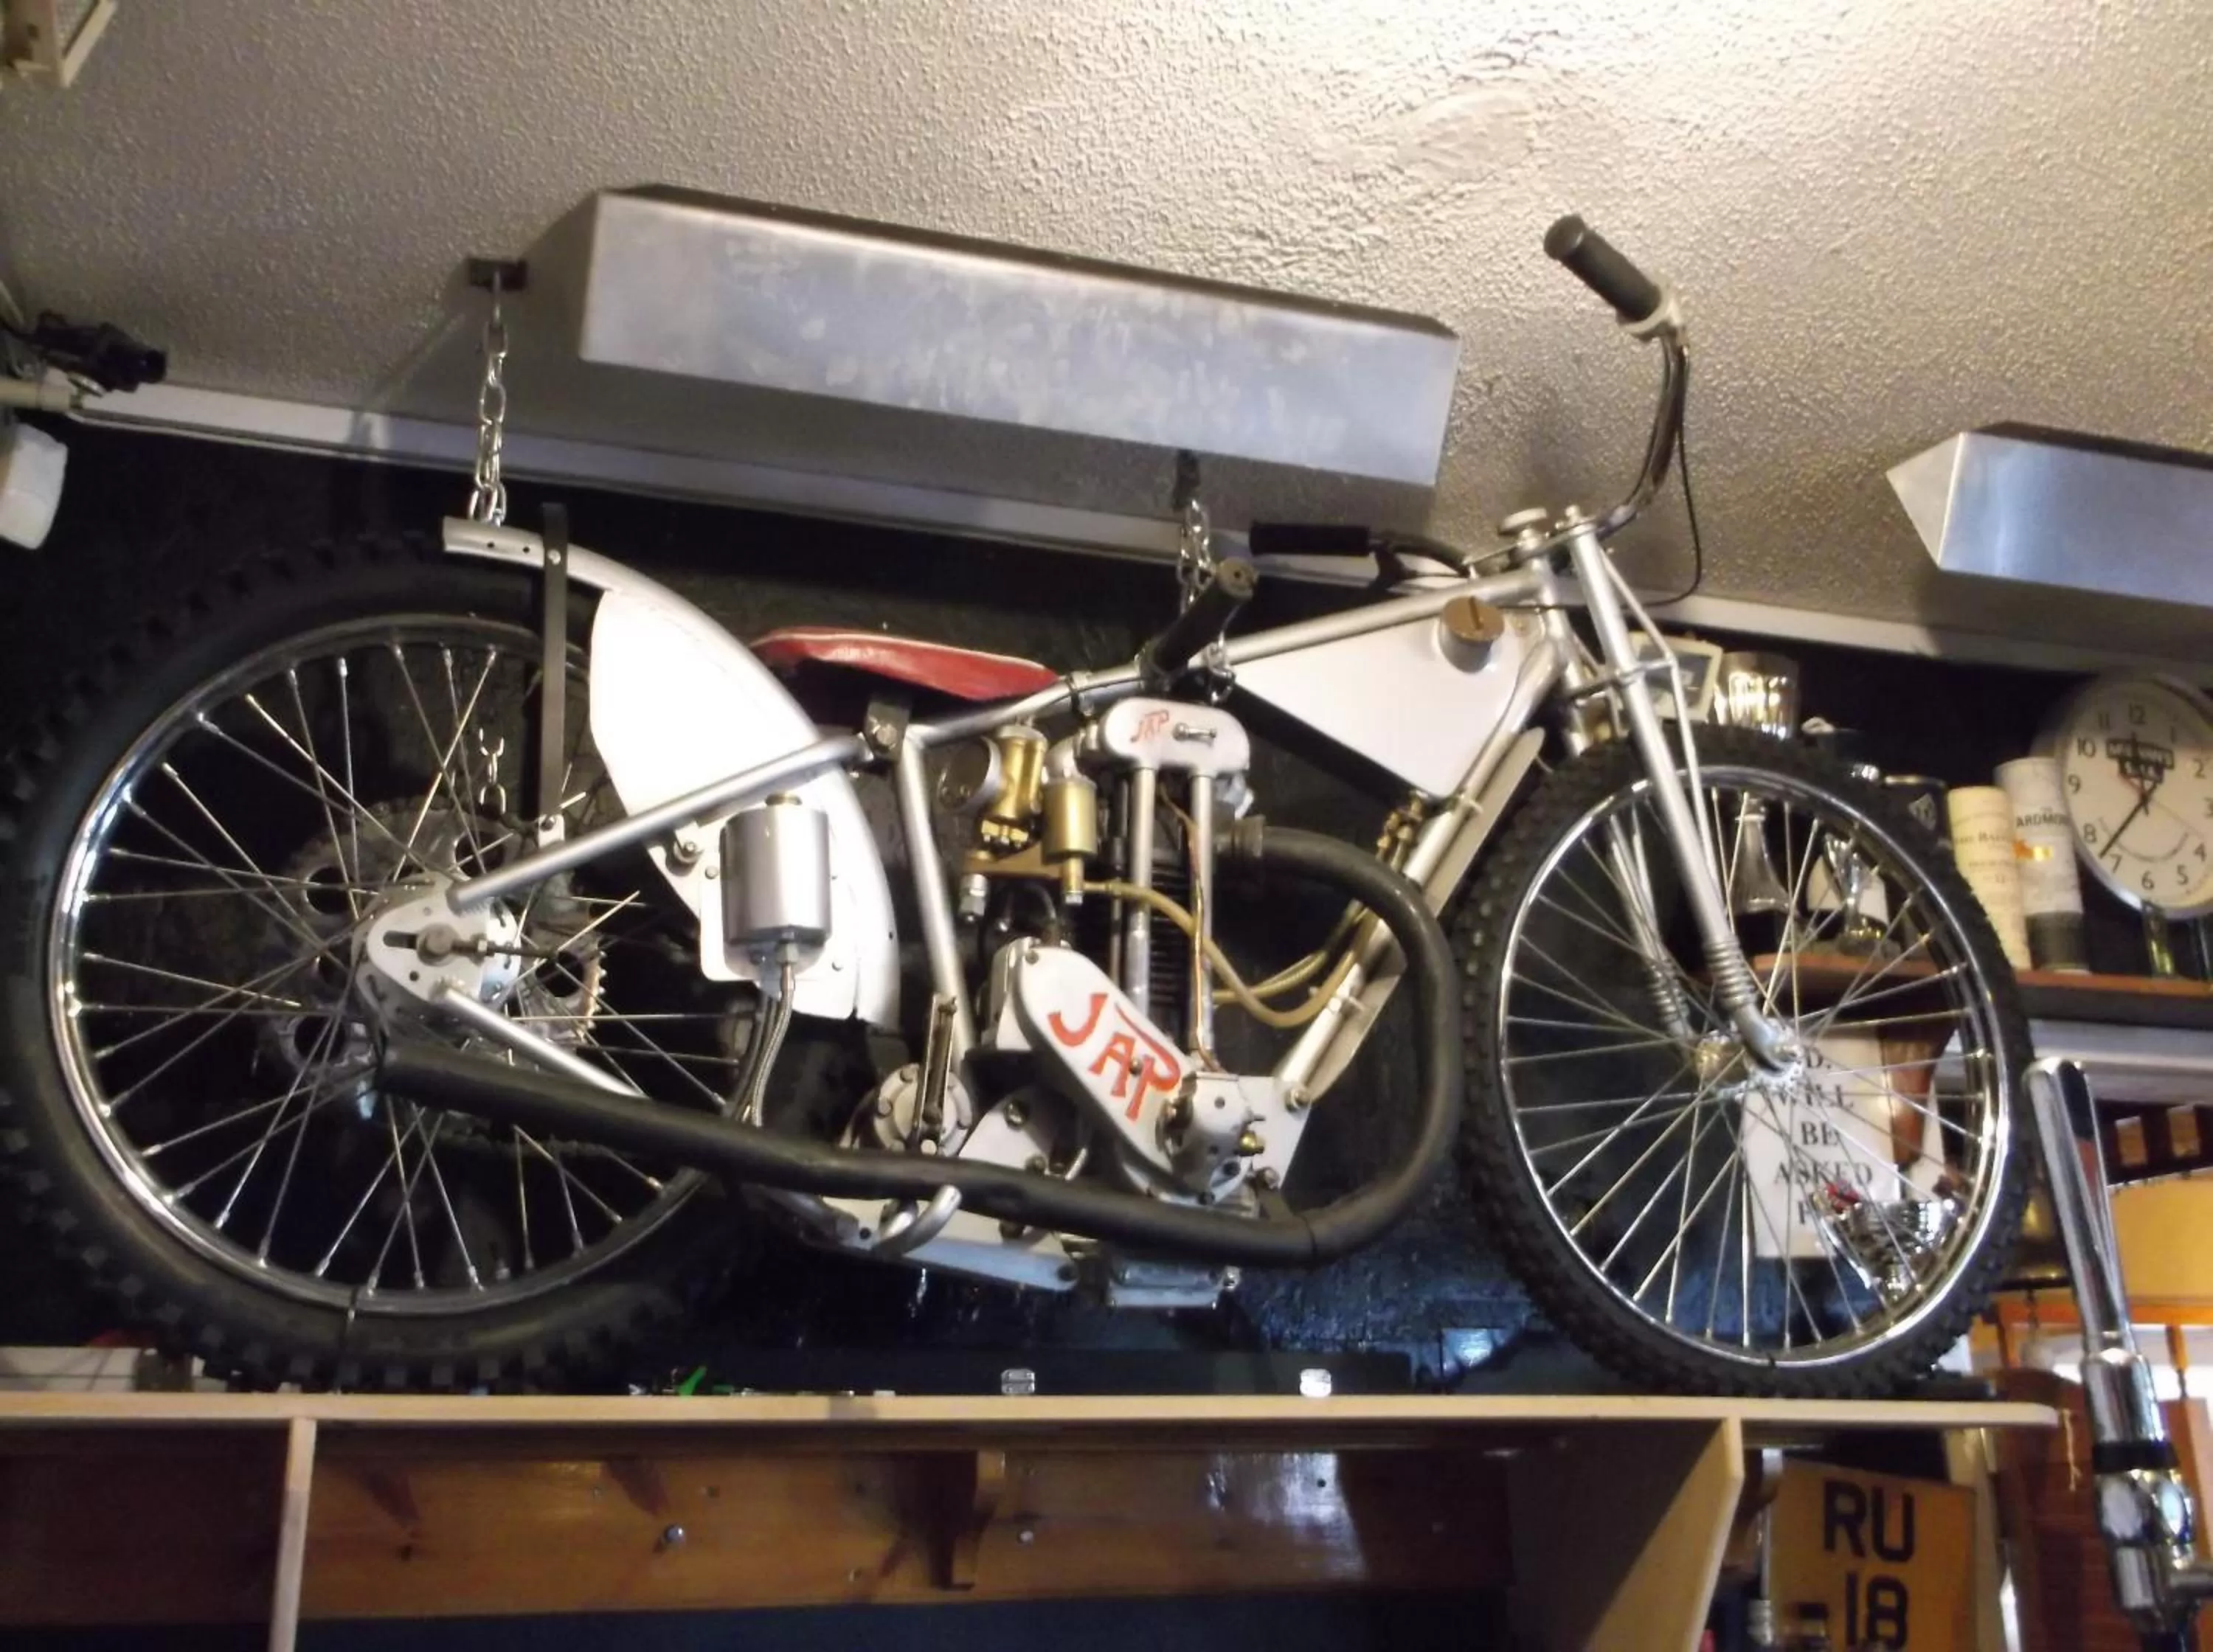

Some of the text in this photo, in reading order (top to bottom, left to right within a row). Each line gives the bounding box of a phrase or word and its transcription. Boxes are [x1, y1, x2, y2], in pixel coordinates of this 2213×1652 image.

[2098, 712, 2110, 730] 11
[2128, 703, 2146, 725] 12
[1129, 709, 1170, 744] JAP
[2077, 738, 2096, 757] 10
[2192, 757, 2206, 780] 2
[2068, 775, 2081, 794] 9
[2082, 823, 2097, 843] 8
[2194, 842, 2206, 861] 4
[2110, 853, 2122, 873] 7
[2141, 870, 2155, 890] 6
[2177, 864, 2189, 886] 5
[1047, 993, 1181, 1120] JAP
[1800, 1120, 1840, 1145] BE
[1774, 1160, 1873, 1186] ASKED
[1824, 1479, 1915, 1563] RU
[1846, 1571, 1908, 1651] 18
